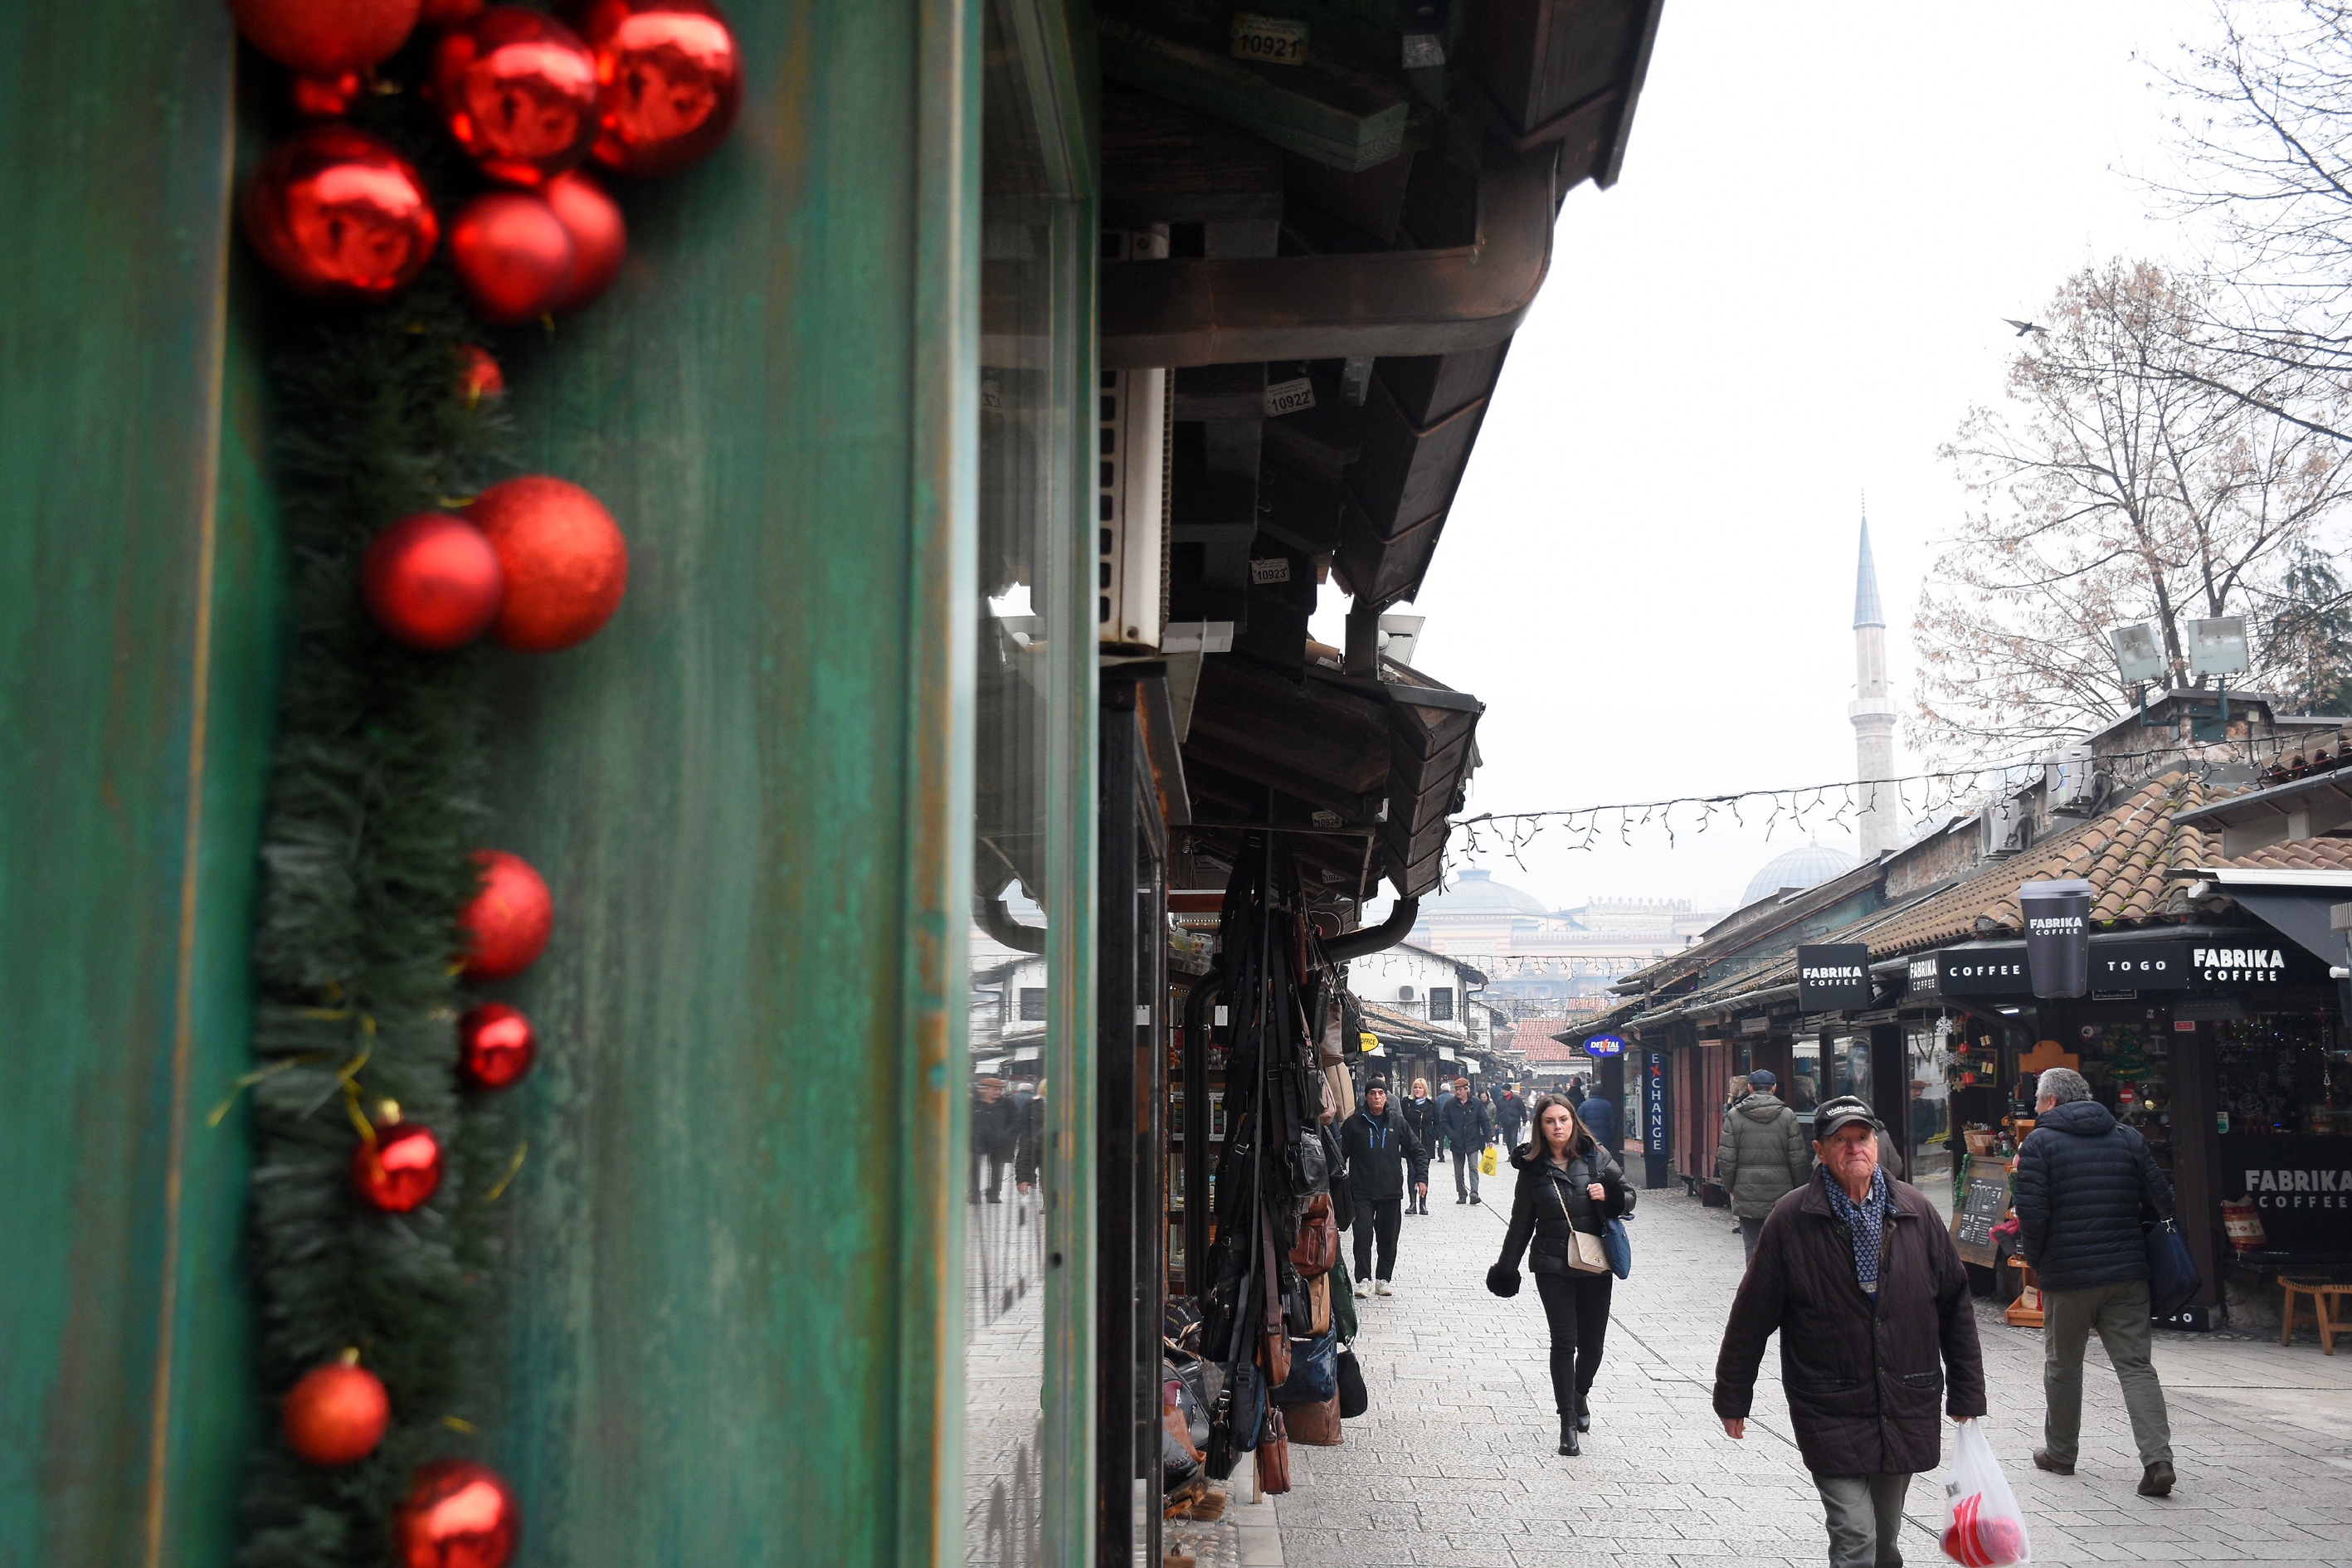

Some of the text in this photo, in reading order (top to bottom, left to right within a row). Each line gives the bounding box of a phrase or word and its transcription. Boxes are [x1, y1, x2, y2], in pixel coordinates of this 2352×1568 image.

[1239, 34, 1298, 58] 10921
[1271, 392, 1310, 411] 10922
[1257, 568, 1286, 581] 10923
[1317, 817, 1339, 827] 10924
[2029, 917, 2082, 929] FABRIKA
[2194, 949, 2285, 967] FABRIKA
[1910, 958, 1937, 979] FABRIKA
[1949, 965, 2019, 976] COFFEE
[2107, 961, 2166, 971] TO GO
[1803, 967, 1863, 979] FABRIKA
[2203, 970, 2277, 981] COFFEE
[1912, 978, 1935, 991] COFFEE
[1650, 1054, 1662, 1150] EXCHANGE
[2245, 1170, 2352, 1191] FABRIKA
[2258, 1195, 2348, 1208] COFFEE
